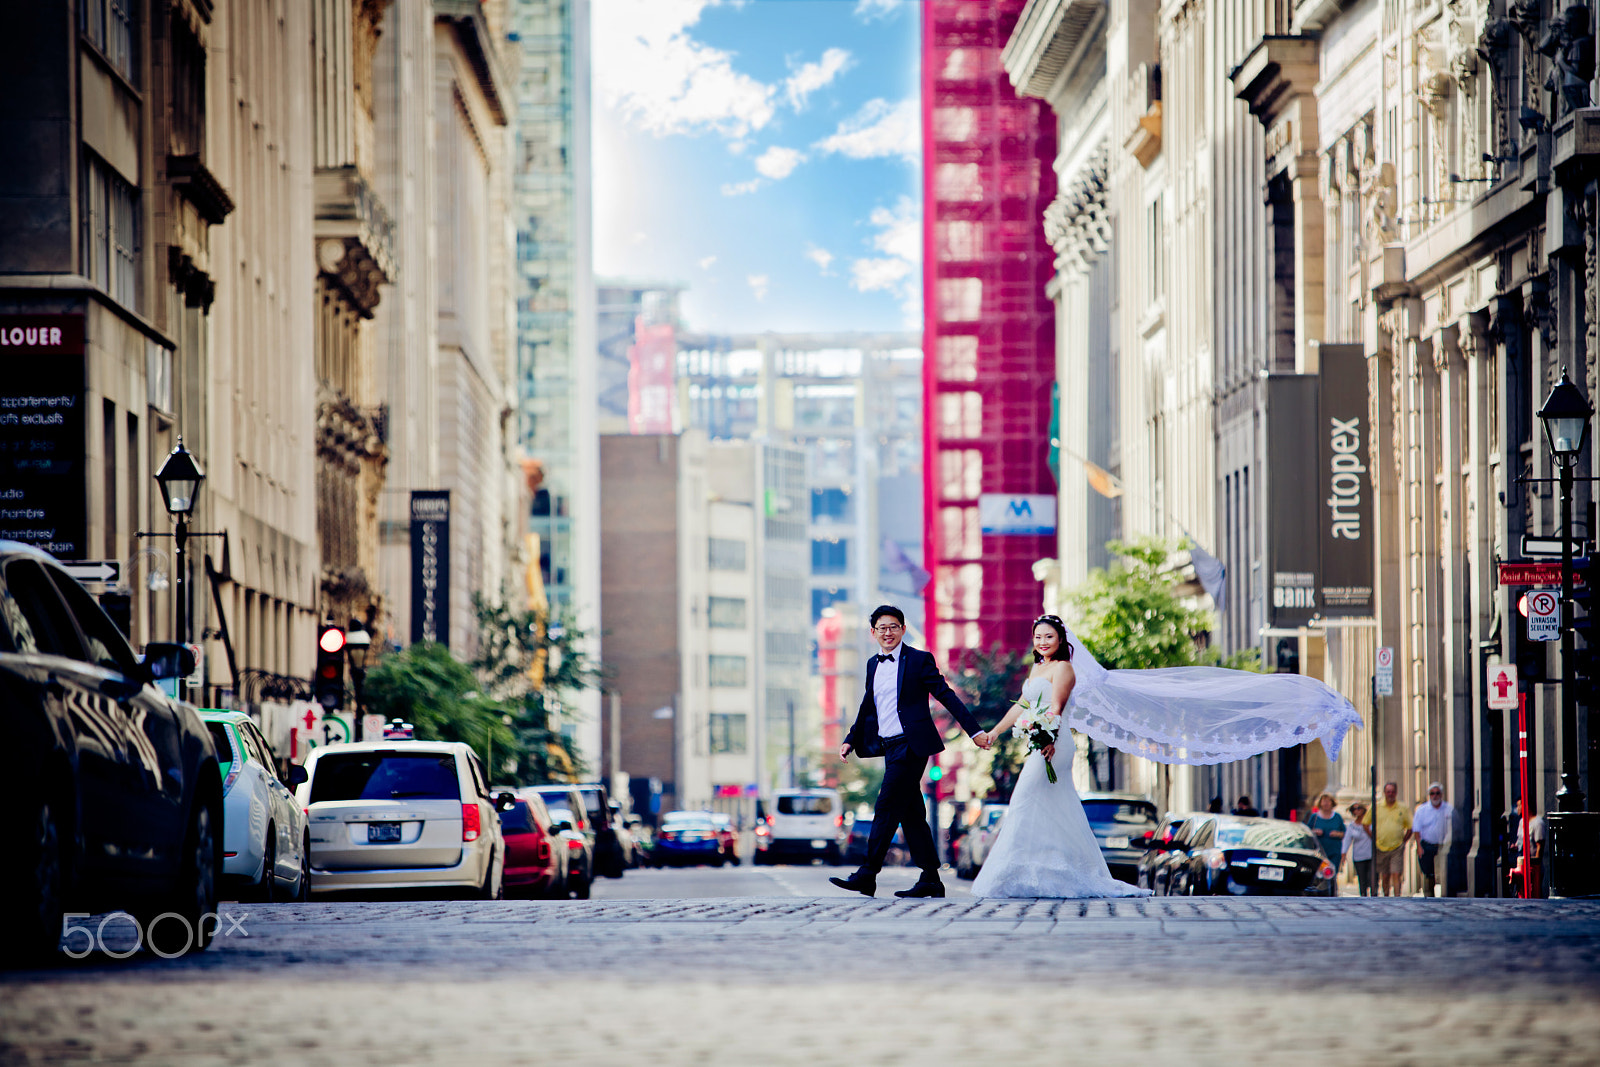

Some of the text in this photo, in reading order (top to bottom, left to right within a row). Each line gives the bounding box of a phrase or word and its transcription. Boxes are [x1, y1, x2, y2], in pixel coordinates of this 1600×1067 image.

[1, 327, 62, 346] LOUER
[1327, 416, 1366, 539] artopex
[1531, 616, 1557, 624] LIVRAISON
